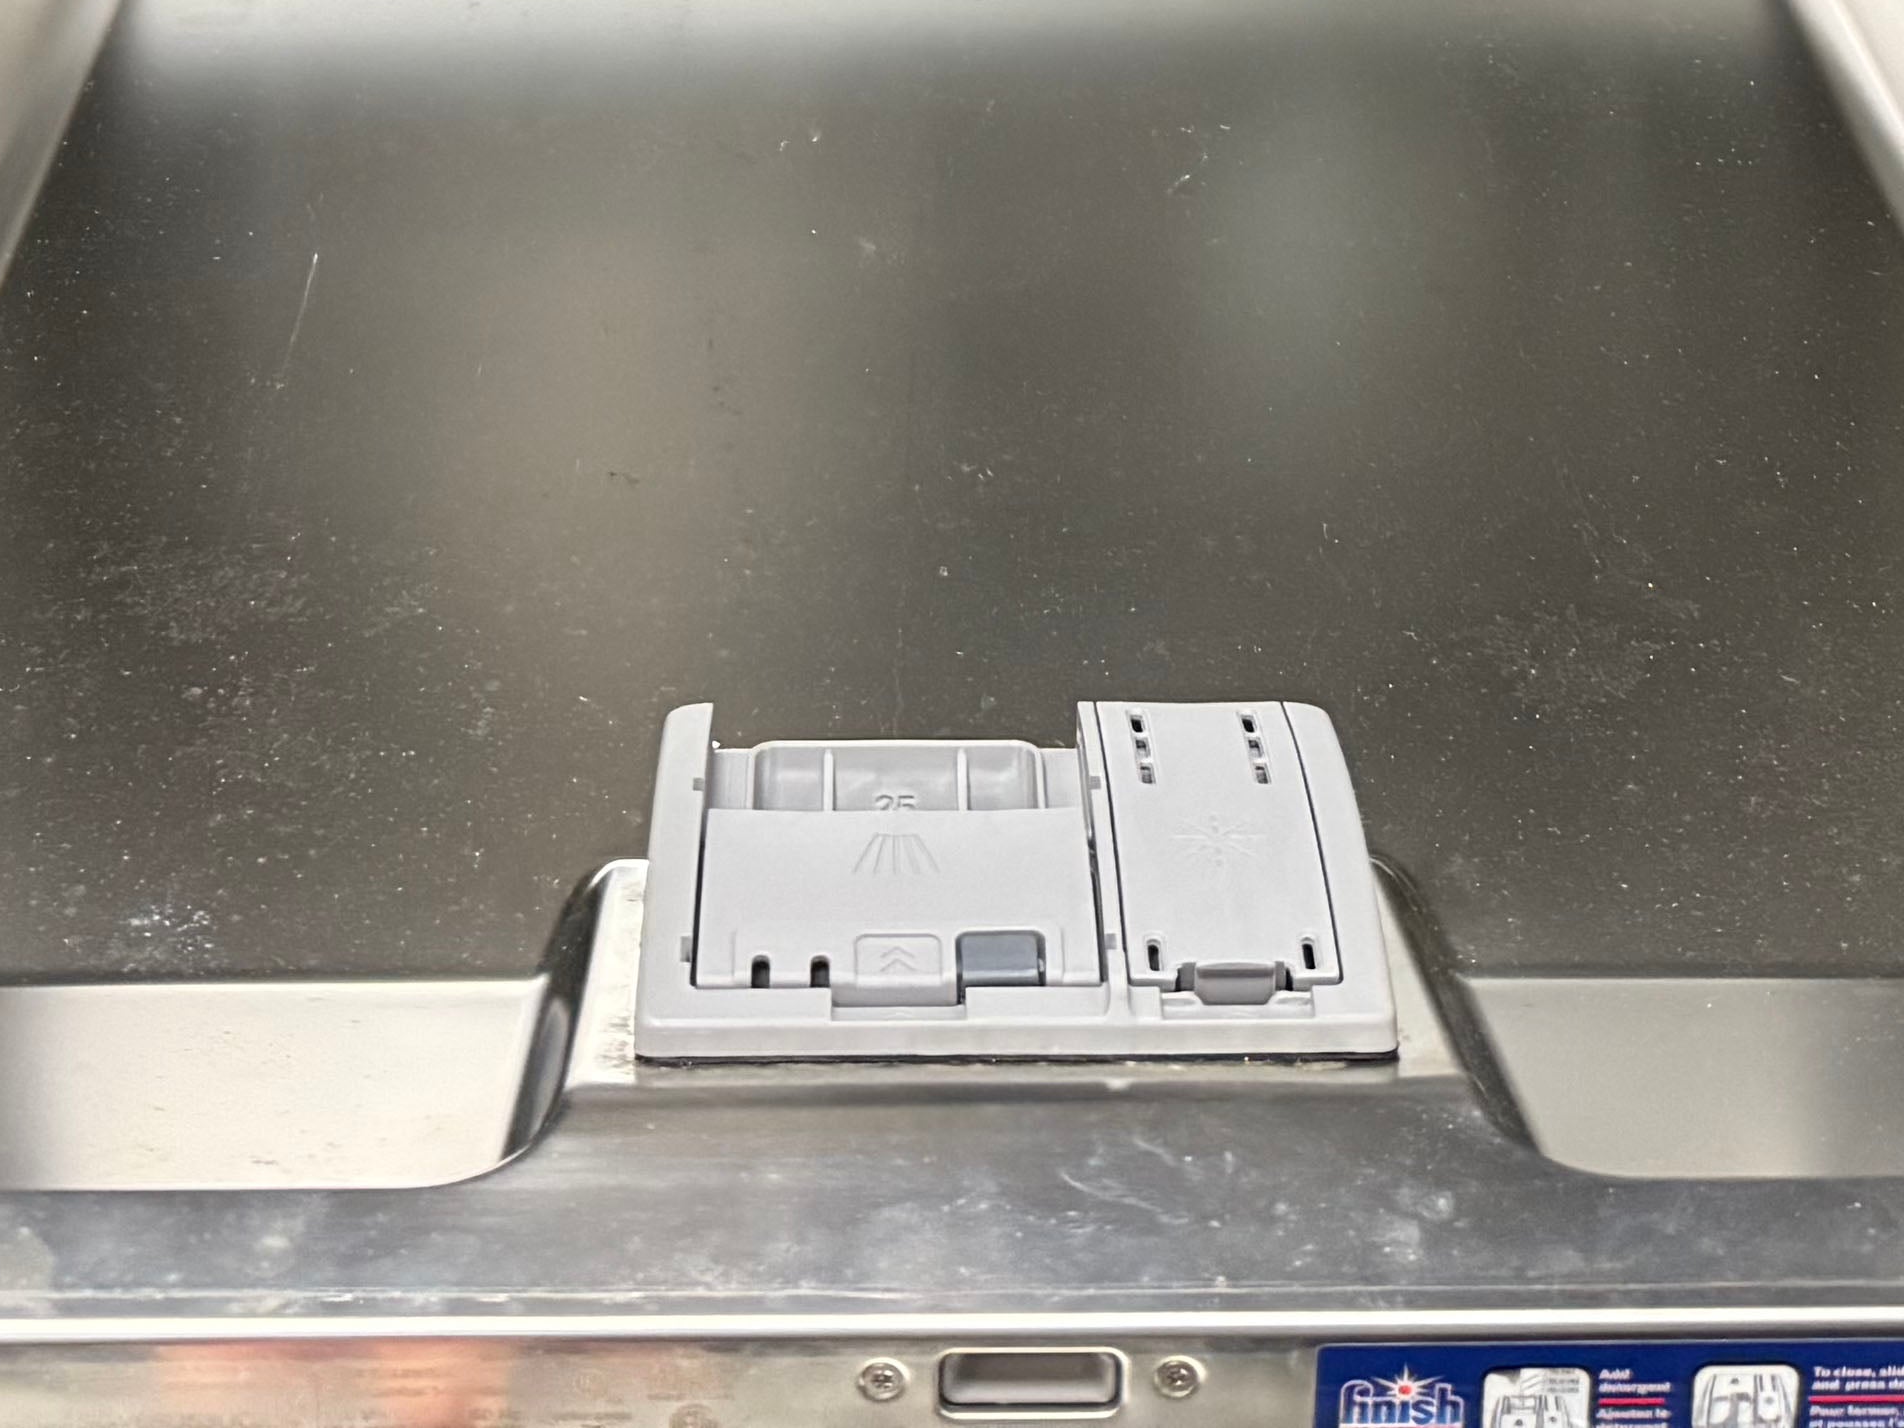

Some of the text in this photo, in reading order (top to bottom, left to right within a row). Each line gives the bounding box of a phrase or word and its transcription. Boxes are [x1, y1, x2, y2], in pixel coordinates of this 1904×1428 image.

[1813, 1366, 1830, 1377] To
[1812, 1379, 1839, 1390] and
[1845, 1380, 1885, 1392] press
[1339, 1379, 1465, 1425] finish
